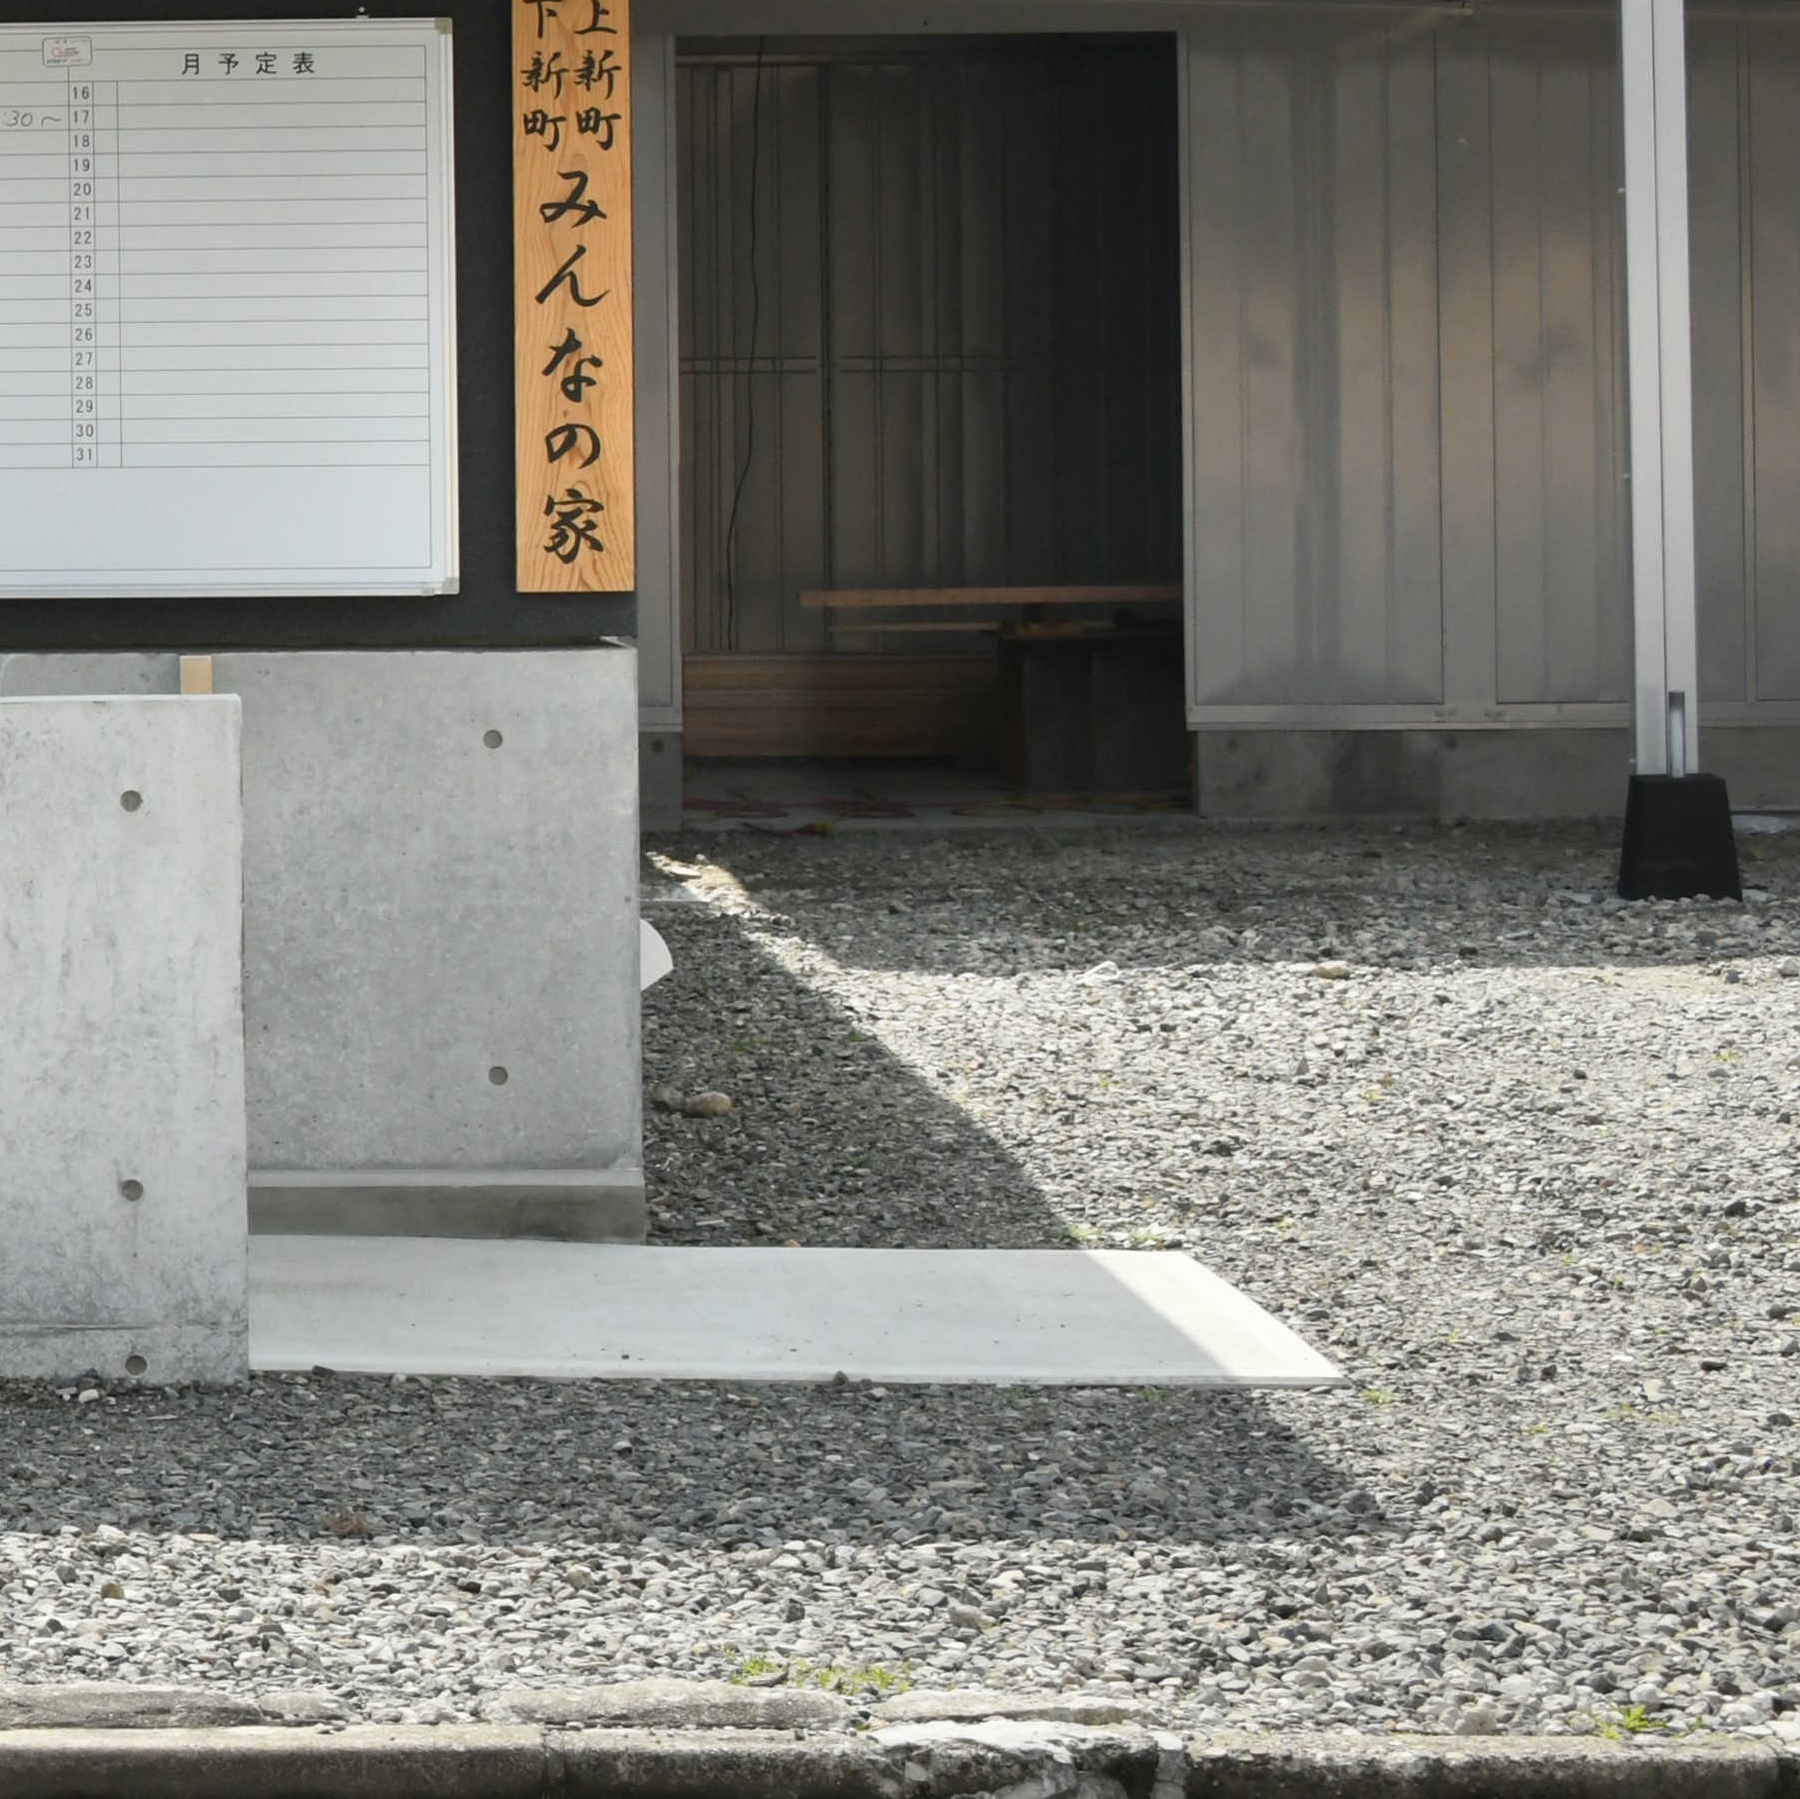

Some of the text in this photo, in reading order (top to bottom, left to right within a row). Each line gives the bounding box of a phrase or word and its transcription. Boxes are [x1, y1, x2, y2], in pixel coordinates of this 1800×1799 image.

[181, 51, 315, 76] 月予定表
[73, 85, 90, 100] 16
[73, 109, 90, 124] 17
[73, 133, 91, 148] 18
[73, 157, 91, 173] 19
[73, 182, 92, 197] 20
[73, 206, 90, 221] 21
[74, 230, 92, 245] 22
[74, 254, 92, 269] 23
[74, 278, 92, 293] 24
[74, 302, 93, 318] 25
[75, 327, 93, 342] 26
[75, 351, 93, 366] 27
[533, 169, 612, 565] みんなの家
[75, 375, 94, 390] 28
[75, 399, 94, 414] 29
[75, 423, 94, 438] 30
[76, 447, 92, 462] 31
